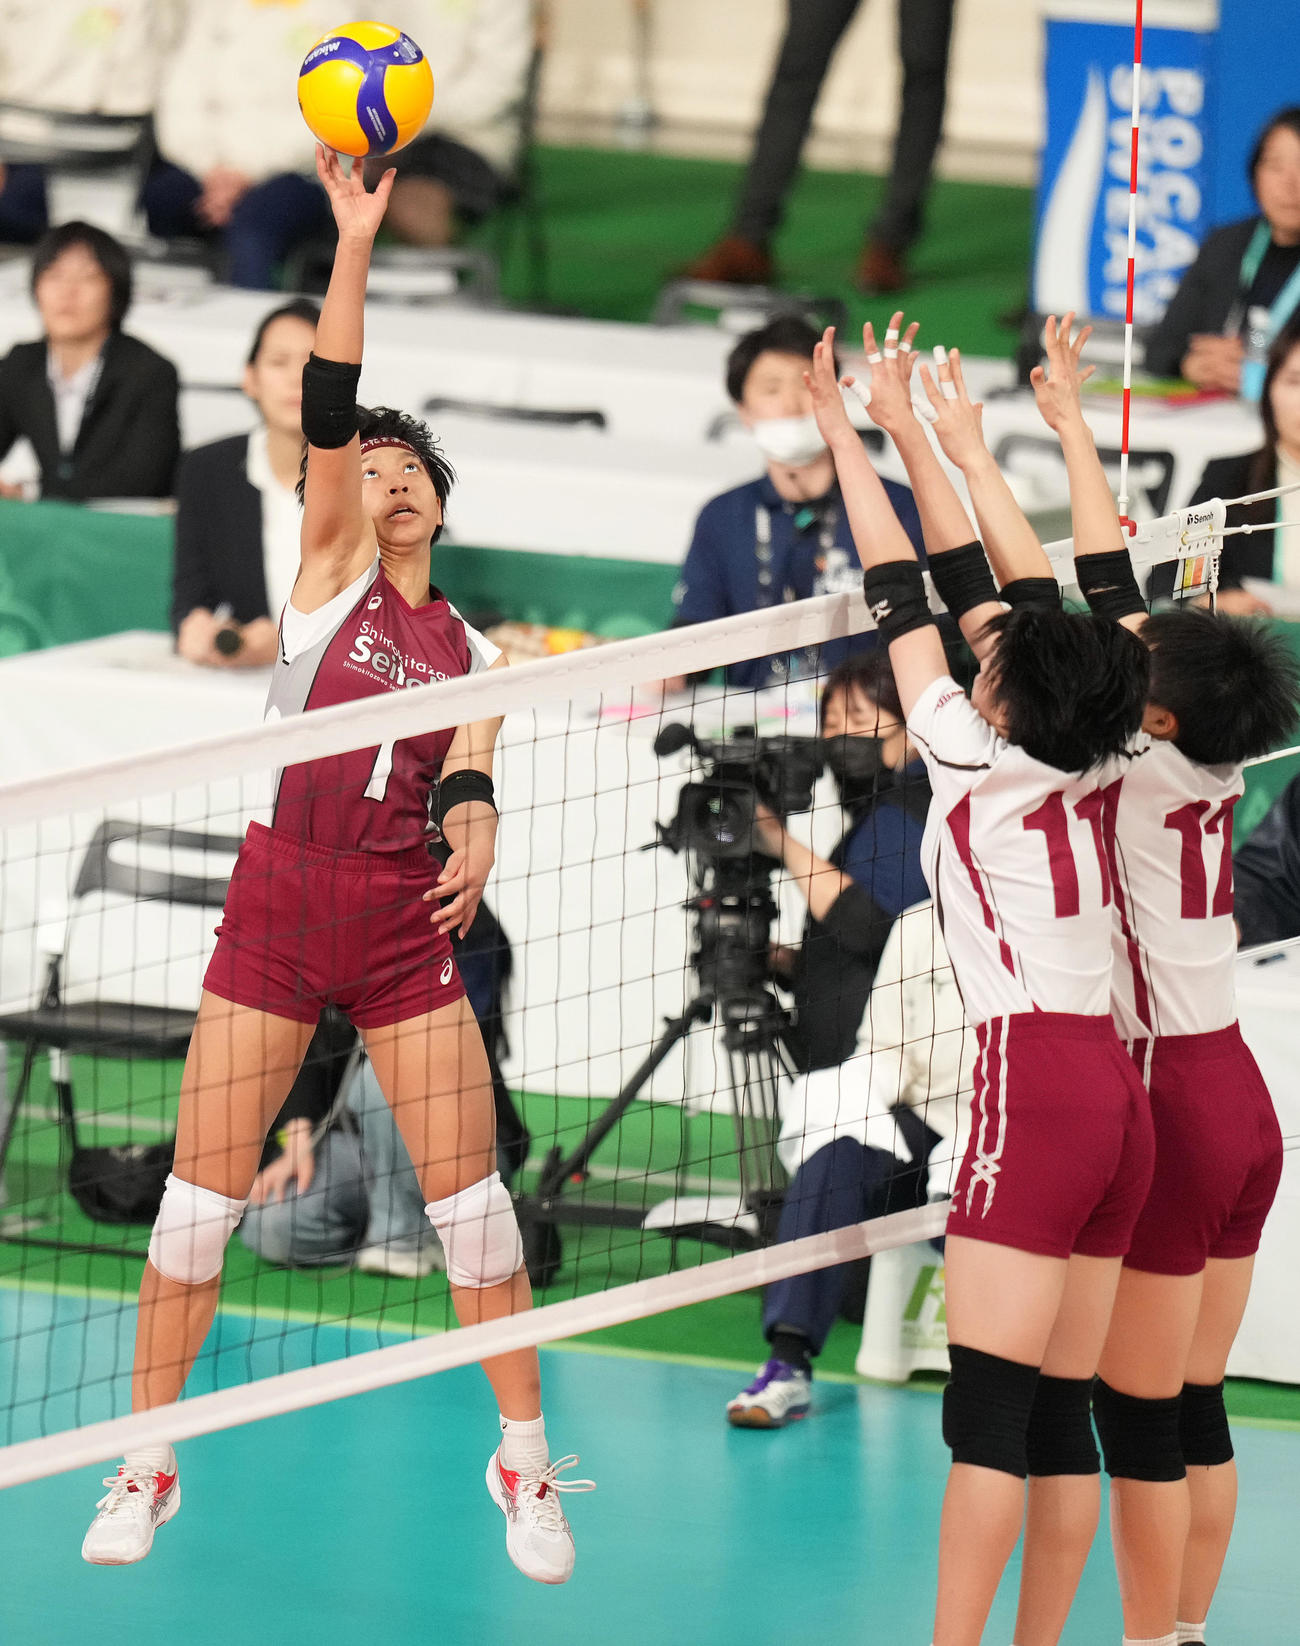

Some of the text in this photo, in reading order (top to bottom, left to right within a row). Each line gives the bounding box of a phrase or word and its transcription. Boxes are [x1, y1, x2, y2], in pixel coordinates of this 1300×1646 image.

[1145, 66, 1204, 322] POCA
[1193, 511, 1214, 525] Senoh
[360, 621, 450, 681] Shimokitaza
[1023, 786, 1112, 919] 11
